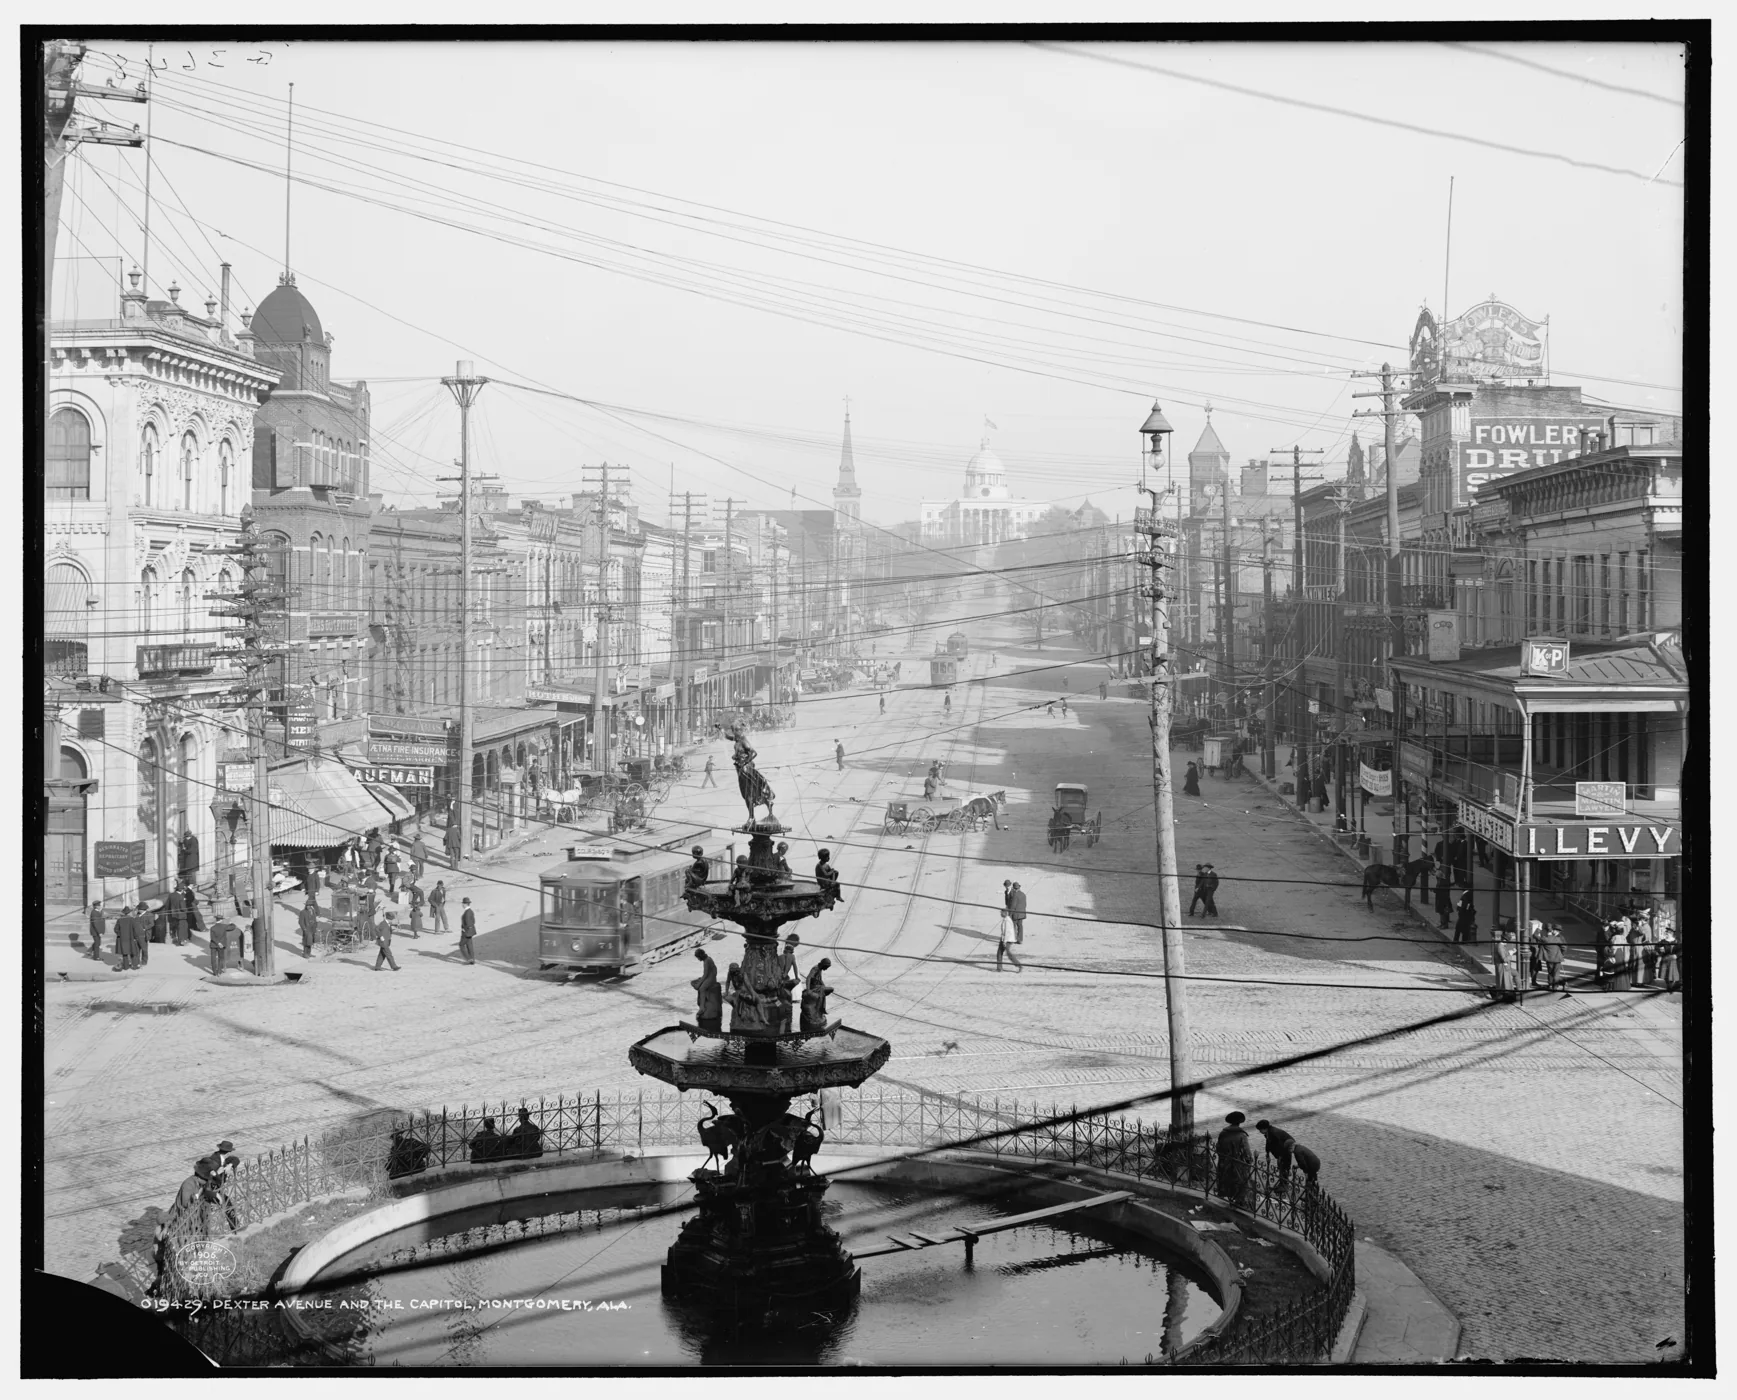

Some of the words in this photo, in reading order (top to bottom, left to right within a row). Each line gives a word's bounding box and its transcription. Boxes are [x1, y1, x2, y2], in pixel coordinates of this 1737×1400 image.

[1535, 648, 1548, 665] K
[1552, 649, 1563, 667] P
[393, 745, 411, 754] FIRE
[353, 768, 430, 784] AUFMAN
[1582, 784, 1621, 797] MARTIN
